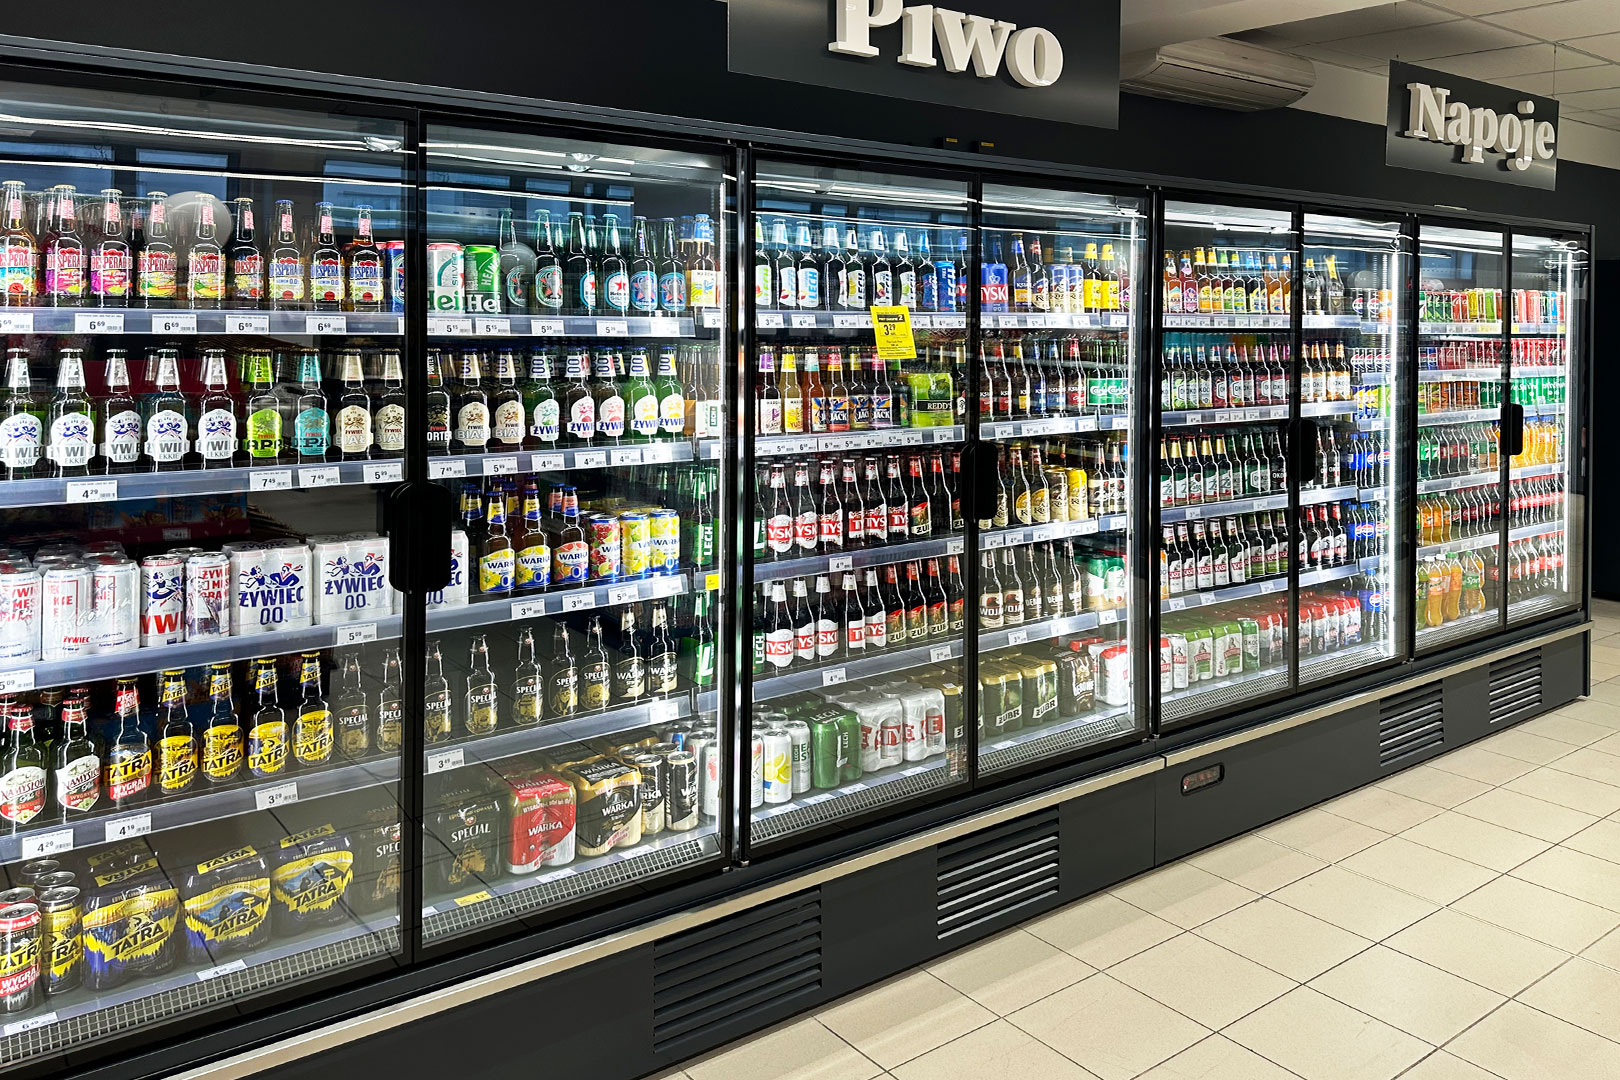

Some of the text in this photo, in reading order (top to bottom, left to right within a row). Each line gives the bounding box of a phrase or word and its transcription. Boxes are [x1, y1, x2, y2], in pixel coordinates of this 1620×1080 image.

[828, 0, 1063, 88] Piwo
[1404, 82, 1555, 171] Napoje
[809, 272, 817, 299] LECH
[704, 526, 712, 556] LECH
[239, 586, 304, 607] ŻYWIEC
[325, 575, 384, 595] ŻYWIEC
[251, 743, 289, 767] TATRA
[296, 734, 333, 756] TATRA
[105, 751, 151, 777] TATRA
[155, 760, 196, 783] TATRA
[203, 750, 242, 772] TATRA
[602, 800, 634, 817] WARKA
[451, 823, 490, 843] SPECJAL
[528, 821, 563, 837] WARKA
[203, 848, 252, 868] TATRA
[293, 882, 337, 907] TATRA
[212, 909, 259, 937] TATRA
[111, 925, 163, 956] TATRA
